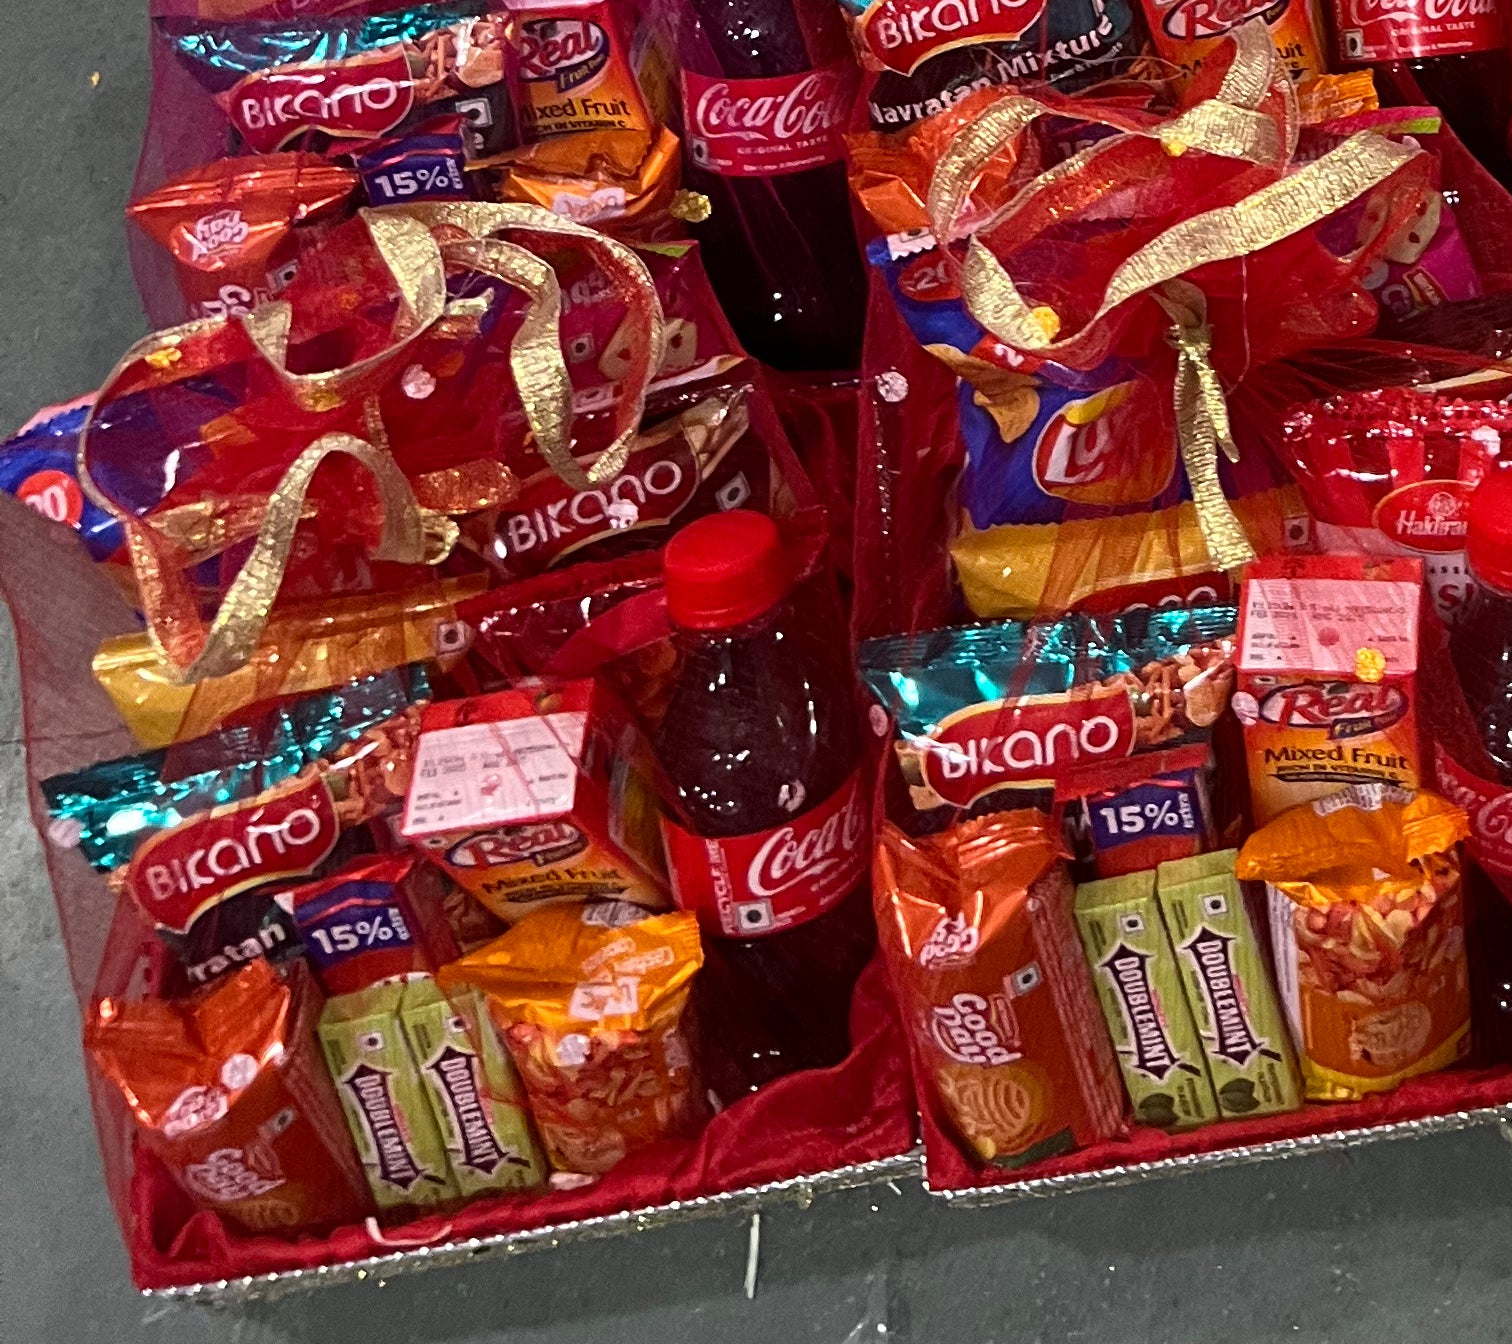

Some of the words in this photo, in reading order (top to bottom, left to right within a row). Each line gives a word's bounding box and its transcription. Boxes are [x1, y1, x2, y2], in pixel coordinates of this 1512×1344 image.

[581, 96, 631, 118] Fruit
[374, 166, 448, 200] 15%
[1265, 743, 1345, 763] Mixed
[1351, 745, 1410, 770] Fruit
[1098, 801, 1178, 834] 15%
[311, 918, 393, 957] 15%
